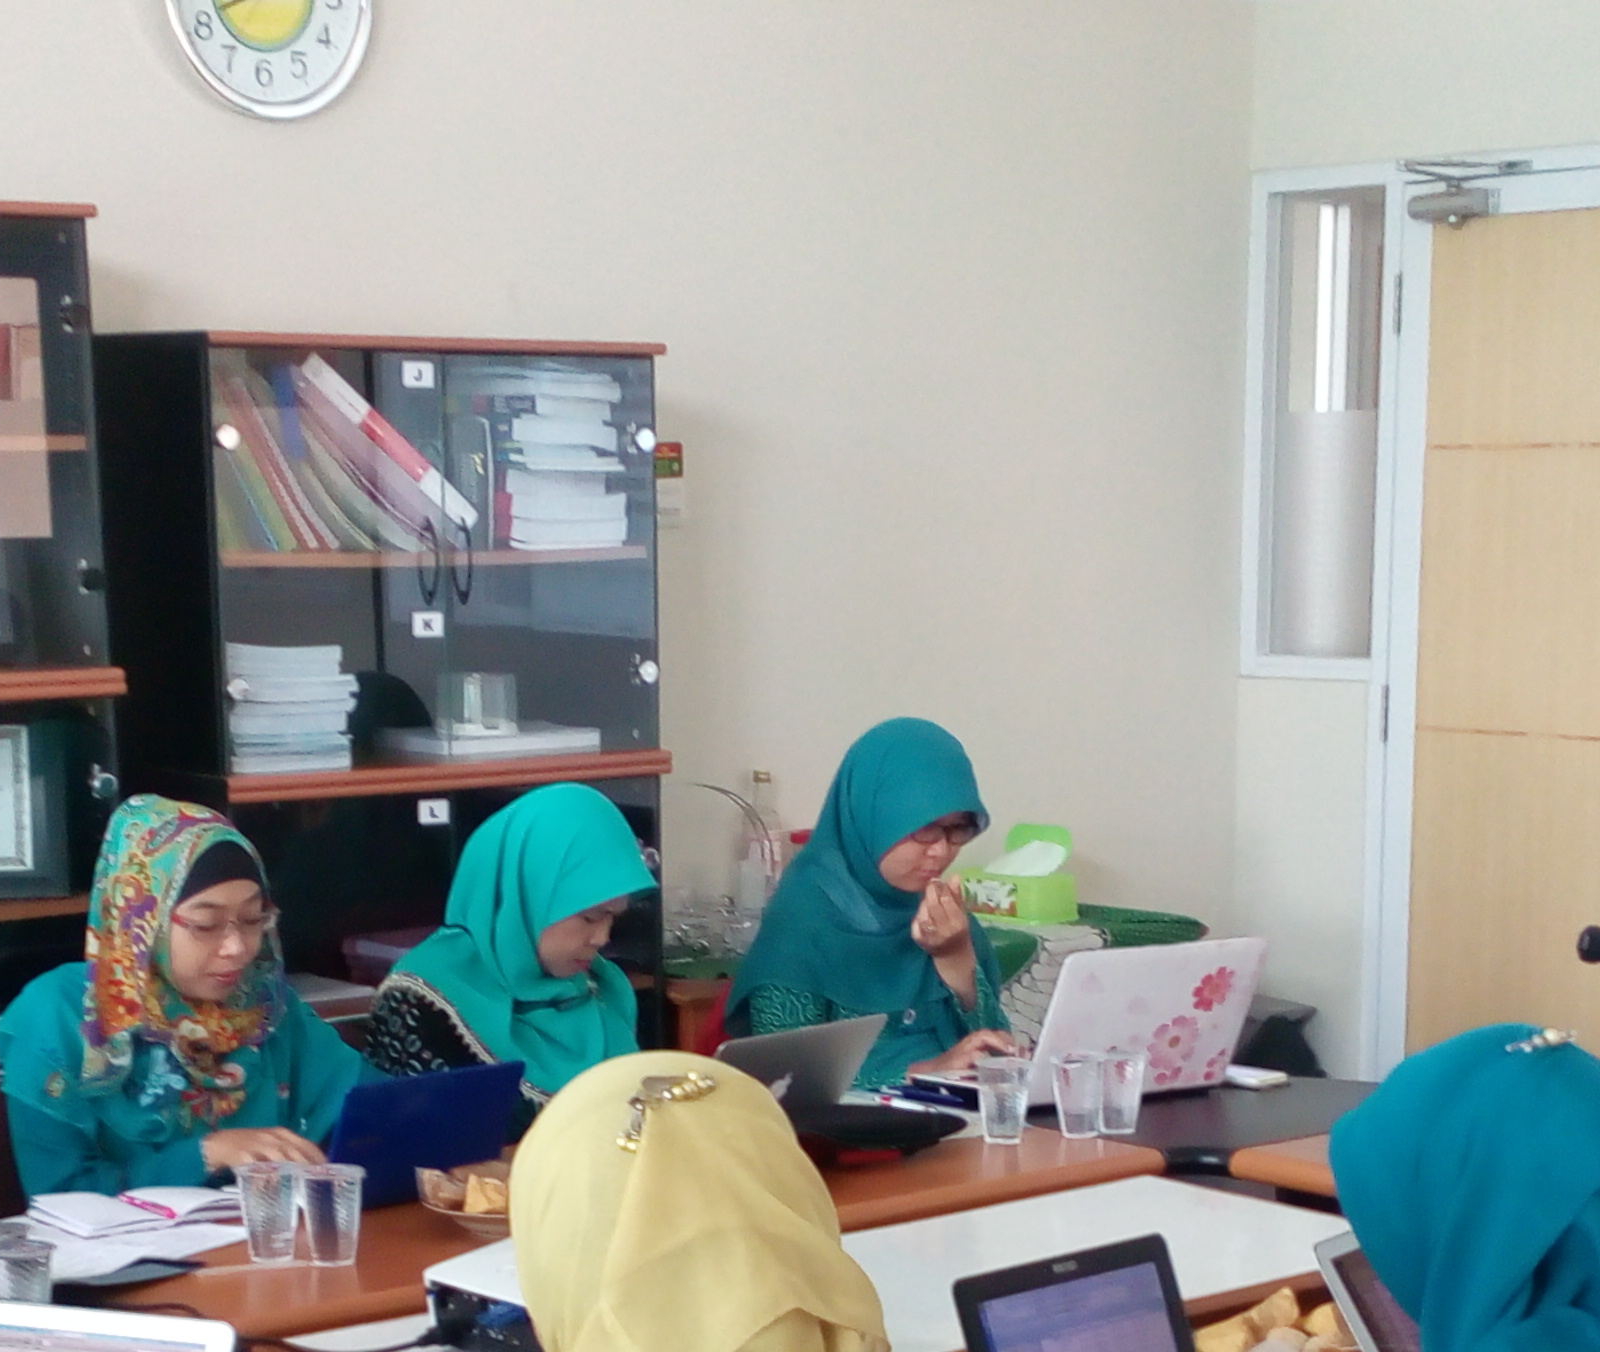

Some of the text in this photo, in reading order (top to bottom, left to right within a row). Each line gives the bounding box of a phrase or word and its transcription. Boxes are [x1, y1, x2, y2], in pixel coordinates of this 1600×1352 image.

[193, 10, 214, 40] 8
[316, 22, 334, 47] 4
[221, 43, 237, 73] 7
[290, 51, 308, 80] 5
[255, 58, 273, 87] 6
[413, 368, 423, 382] J
[422, 618, 434, 632] K
[429, 806, 440, 819] L
